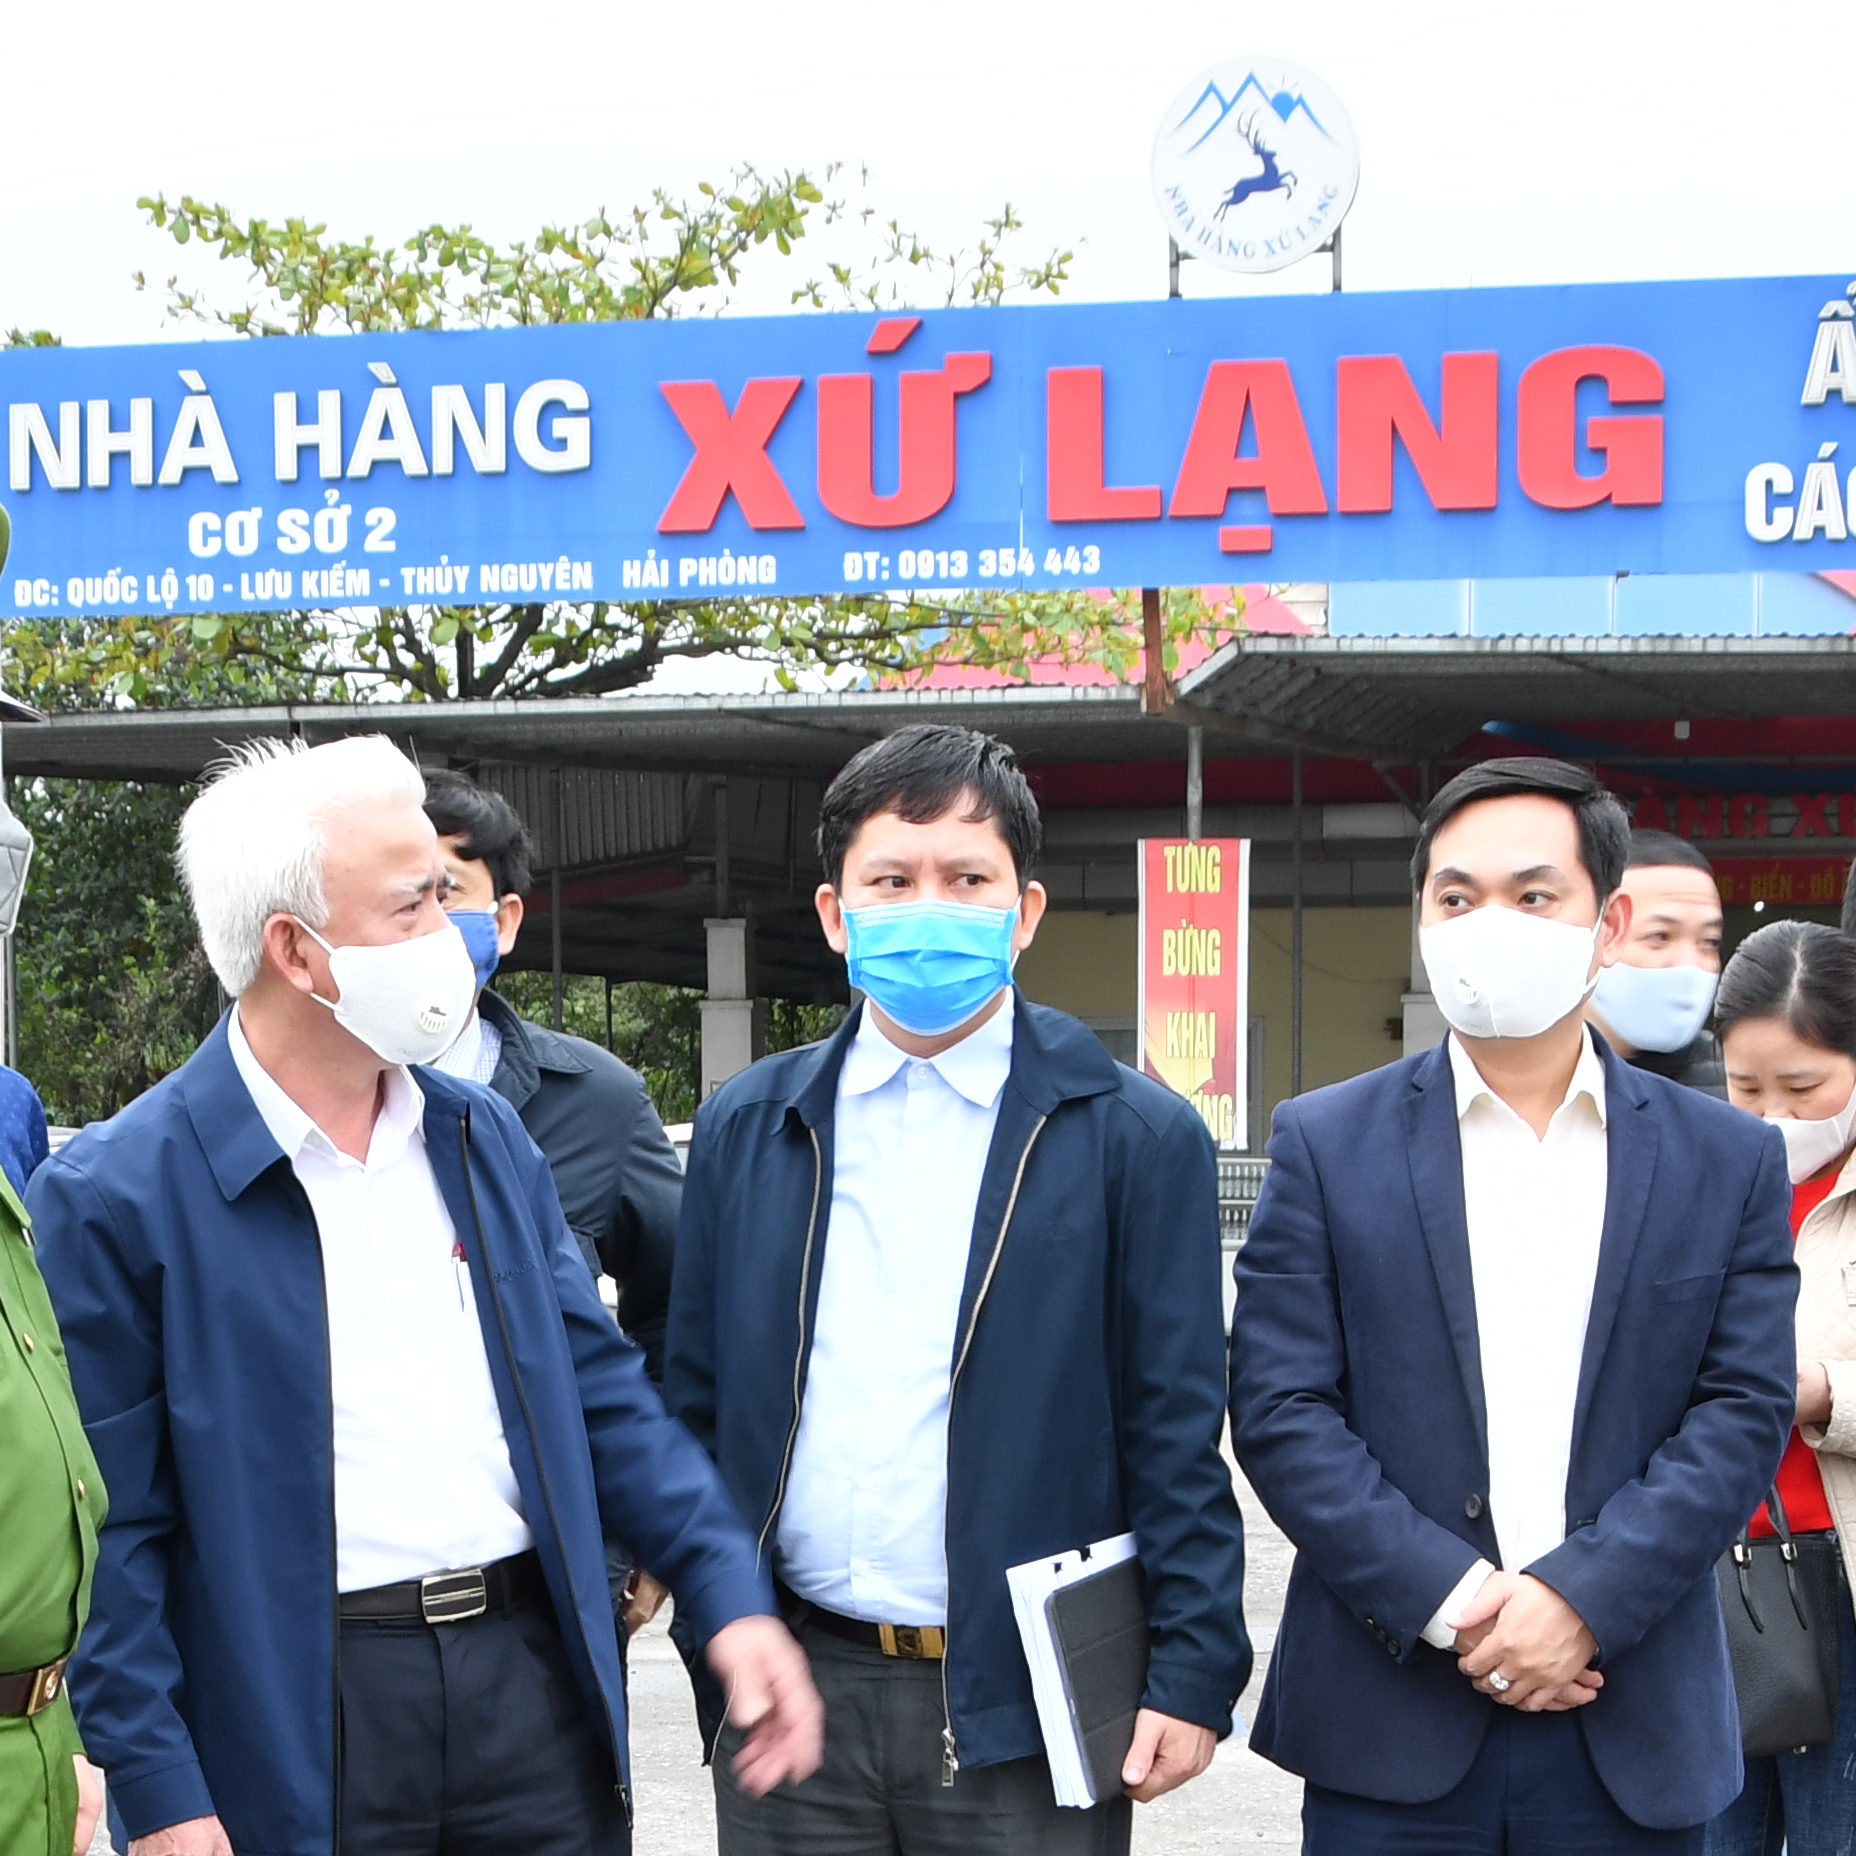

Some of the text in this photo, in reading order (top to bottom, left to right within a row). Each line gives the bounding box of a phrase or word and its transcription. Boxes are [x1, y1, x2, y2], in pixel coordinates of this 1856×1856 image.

[9, 362, 590, 489] NHÀ HÀNG
[657, 317, 1666, 553] XỨ LẠNG
[189, 489, 396, 557] CƠ SỞ 2
[14, 579, 58, 607] ĐC:
[67, 567, 138, 607] QUỐC
[147, 568, 178, 609] LỘ
[186, 574, 214, 601] 10
[241, 568, 292, 600] LƯU
[302, 560, 370, 598] KIẾM
[401, 555, 469, 595] THỦY
[480, 556, 593, 592] NGUYÊN
[623, 549, 669, 588] HẢI
[680, 549, 776, 586] PHÒNG
[843, 544, 1100, 581] ĐT: 0913 354 443
[1162, 918, 1221, 976] BỪNG
[1165, 1011, 1217, 1059] KHAI
